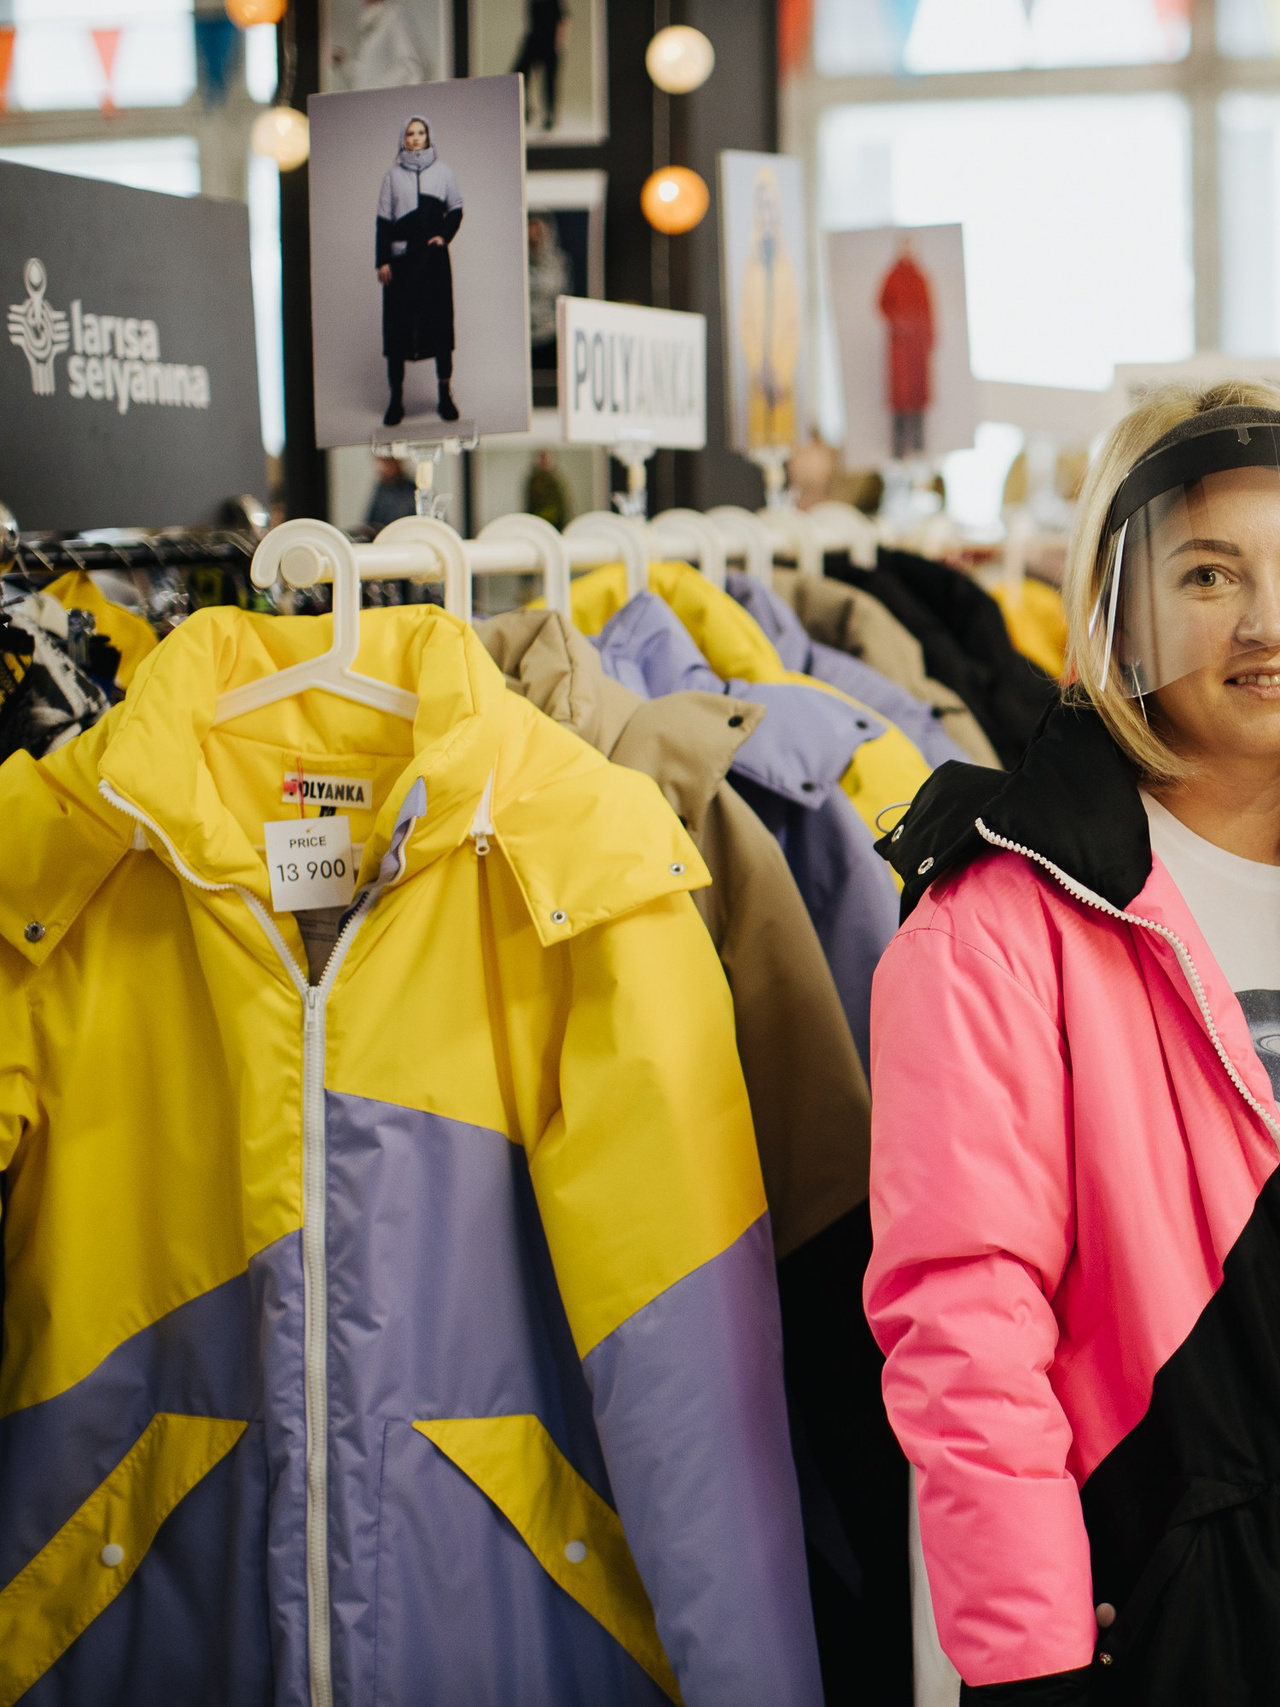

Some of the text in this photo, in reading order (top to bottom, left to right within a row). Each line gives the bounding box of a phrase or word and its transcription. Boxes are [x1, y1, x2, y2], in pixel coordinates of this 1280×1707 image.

[289, 835, 327, 848] PRICE
[276, 858, 346, 882] 13 900
